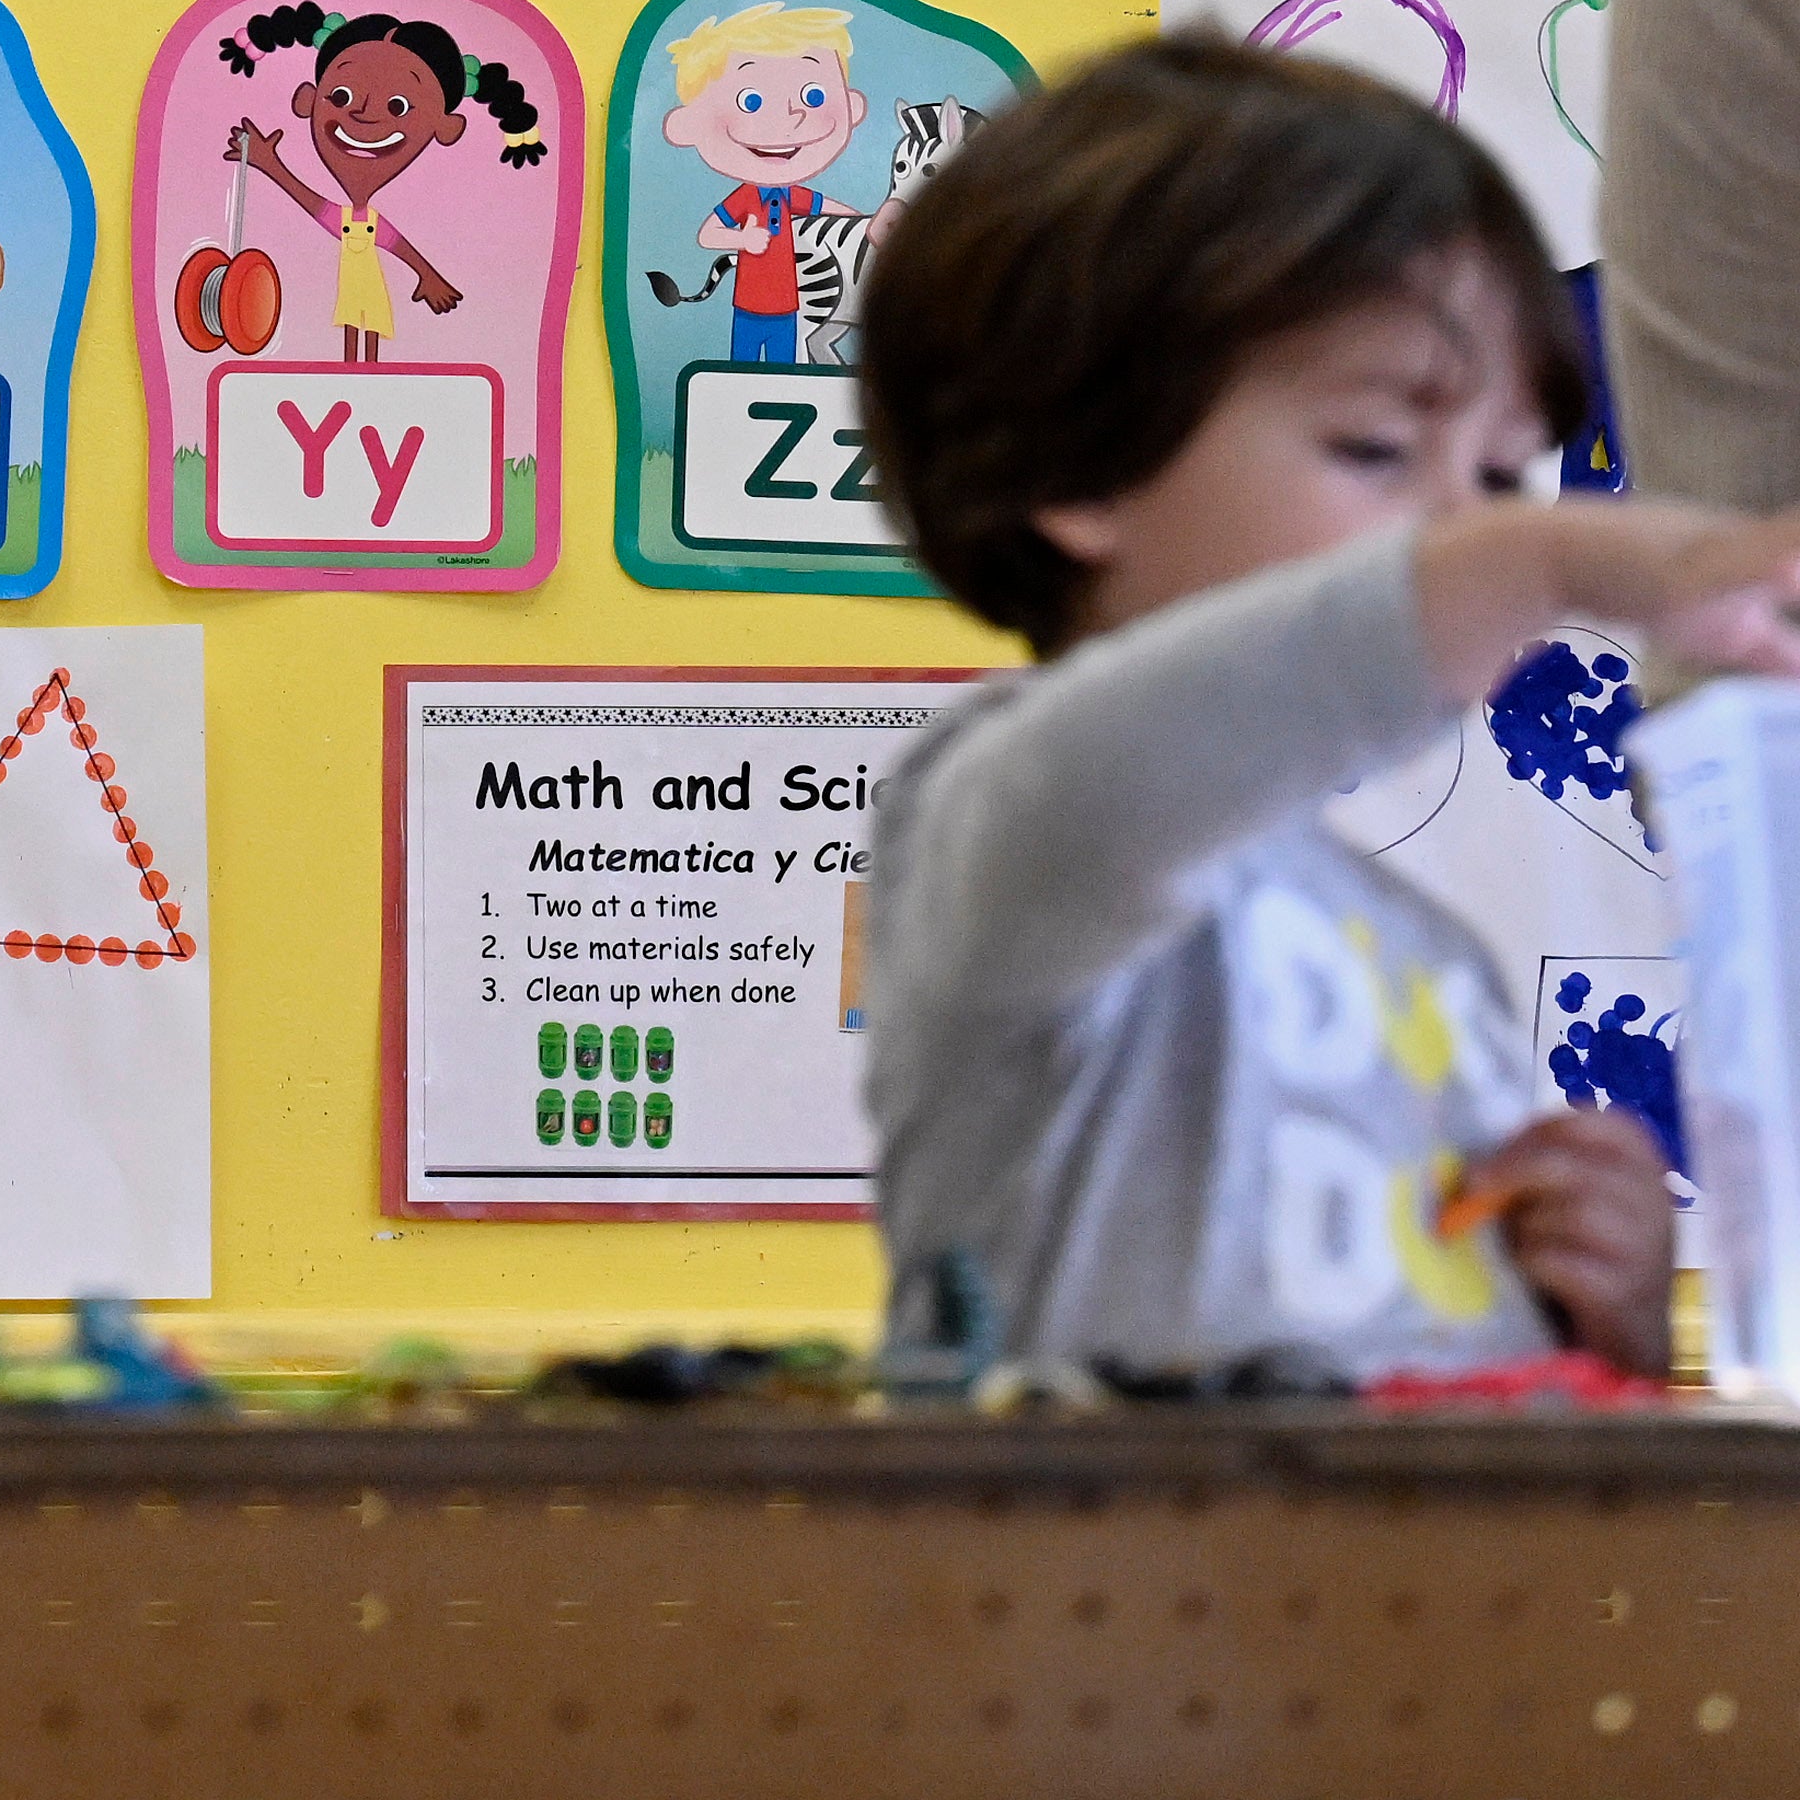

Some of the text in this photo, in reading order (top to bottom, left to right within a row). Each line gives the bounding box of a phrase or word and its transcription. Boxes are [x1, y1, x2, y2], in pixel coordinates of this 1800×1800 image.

[277, 400, 424, 527] Yy
[744, 401, 886, 502] Zz
[476, 760, 623, 810] Math
[653, 761, 750, 810] and
[529, 840, 754, 873] Matematica
[775, 851, 797, 883] y
[482, 892, 717, 918] 1. Two at a time
[482, 935, 814, 968] 2. Use materials safely
[482, 977, 796, 1009] 3. Clean up when done
